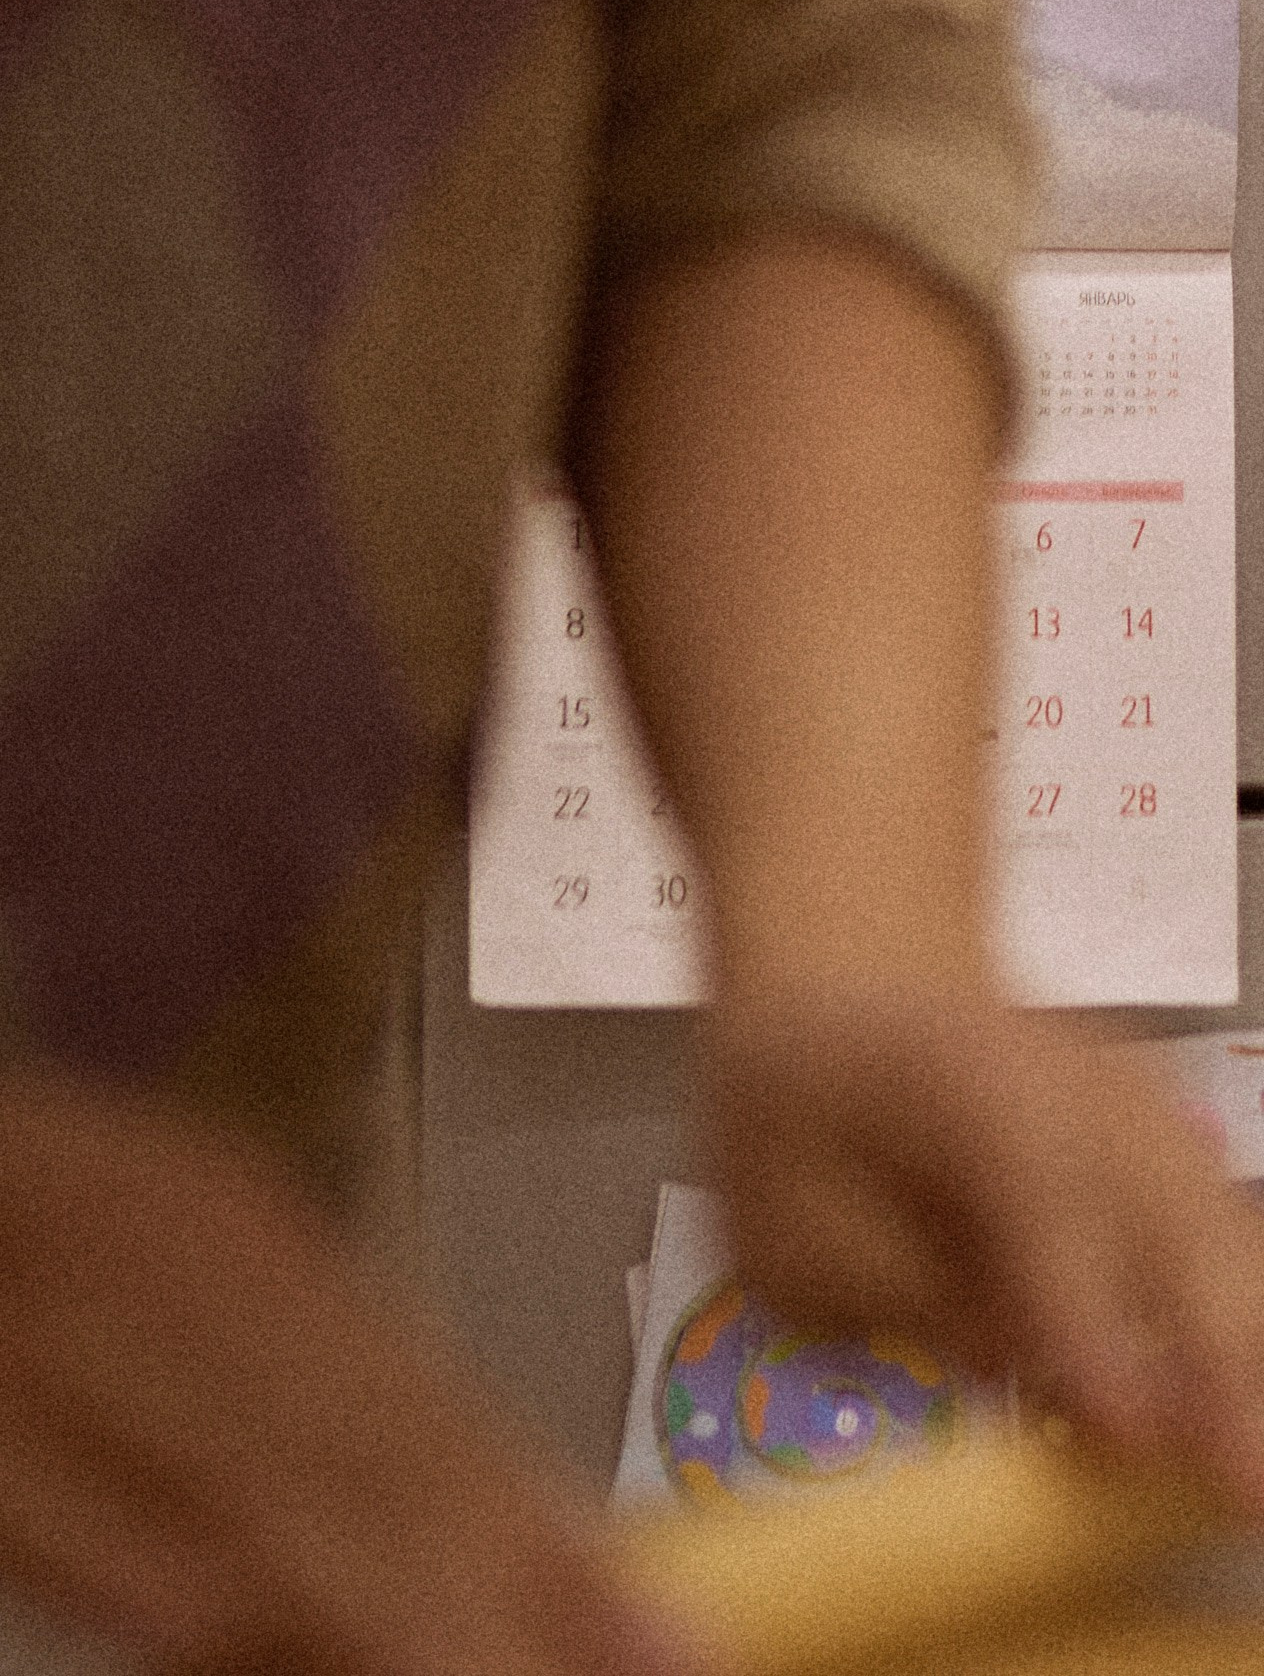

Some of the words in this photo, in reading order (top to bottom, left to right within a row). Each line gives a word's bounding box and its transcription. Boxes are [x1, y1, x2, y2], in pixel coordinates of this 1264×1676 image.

[1079, 290, 1137, 307] ЯНВАРЬ
[1036, 520, 1054, 553] 6
[1129, 518, 1146, 552] 7
[566, 607, 585, 640] 8
[1028, 605, 1061, 641] 13
[1122, 605, 1154, 641] 14
[558, 695, 591, 730] 15
[1026, 694, 1064, 730] 20
[1120, 693, 1154, 729] 21
[553, 785, 591, 821] 22
[1027, 783, 1062, 818] 27
[1120, 781, 1157, 818] 28
[552, 874, 591, 911] 29
[650, 874, 688, 910] 30
